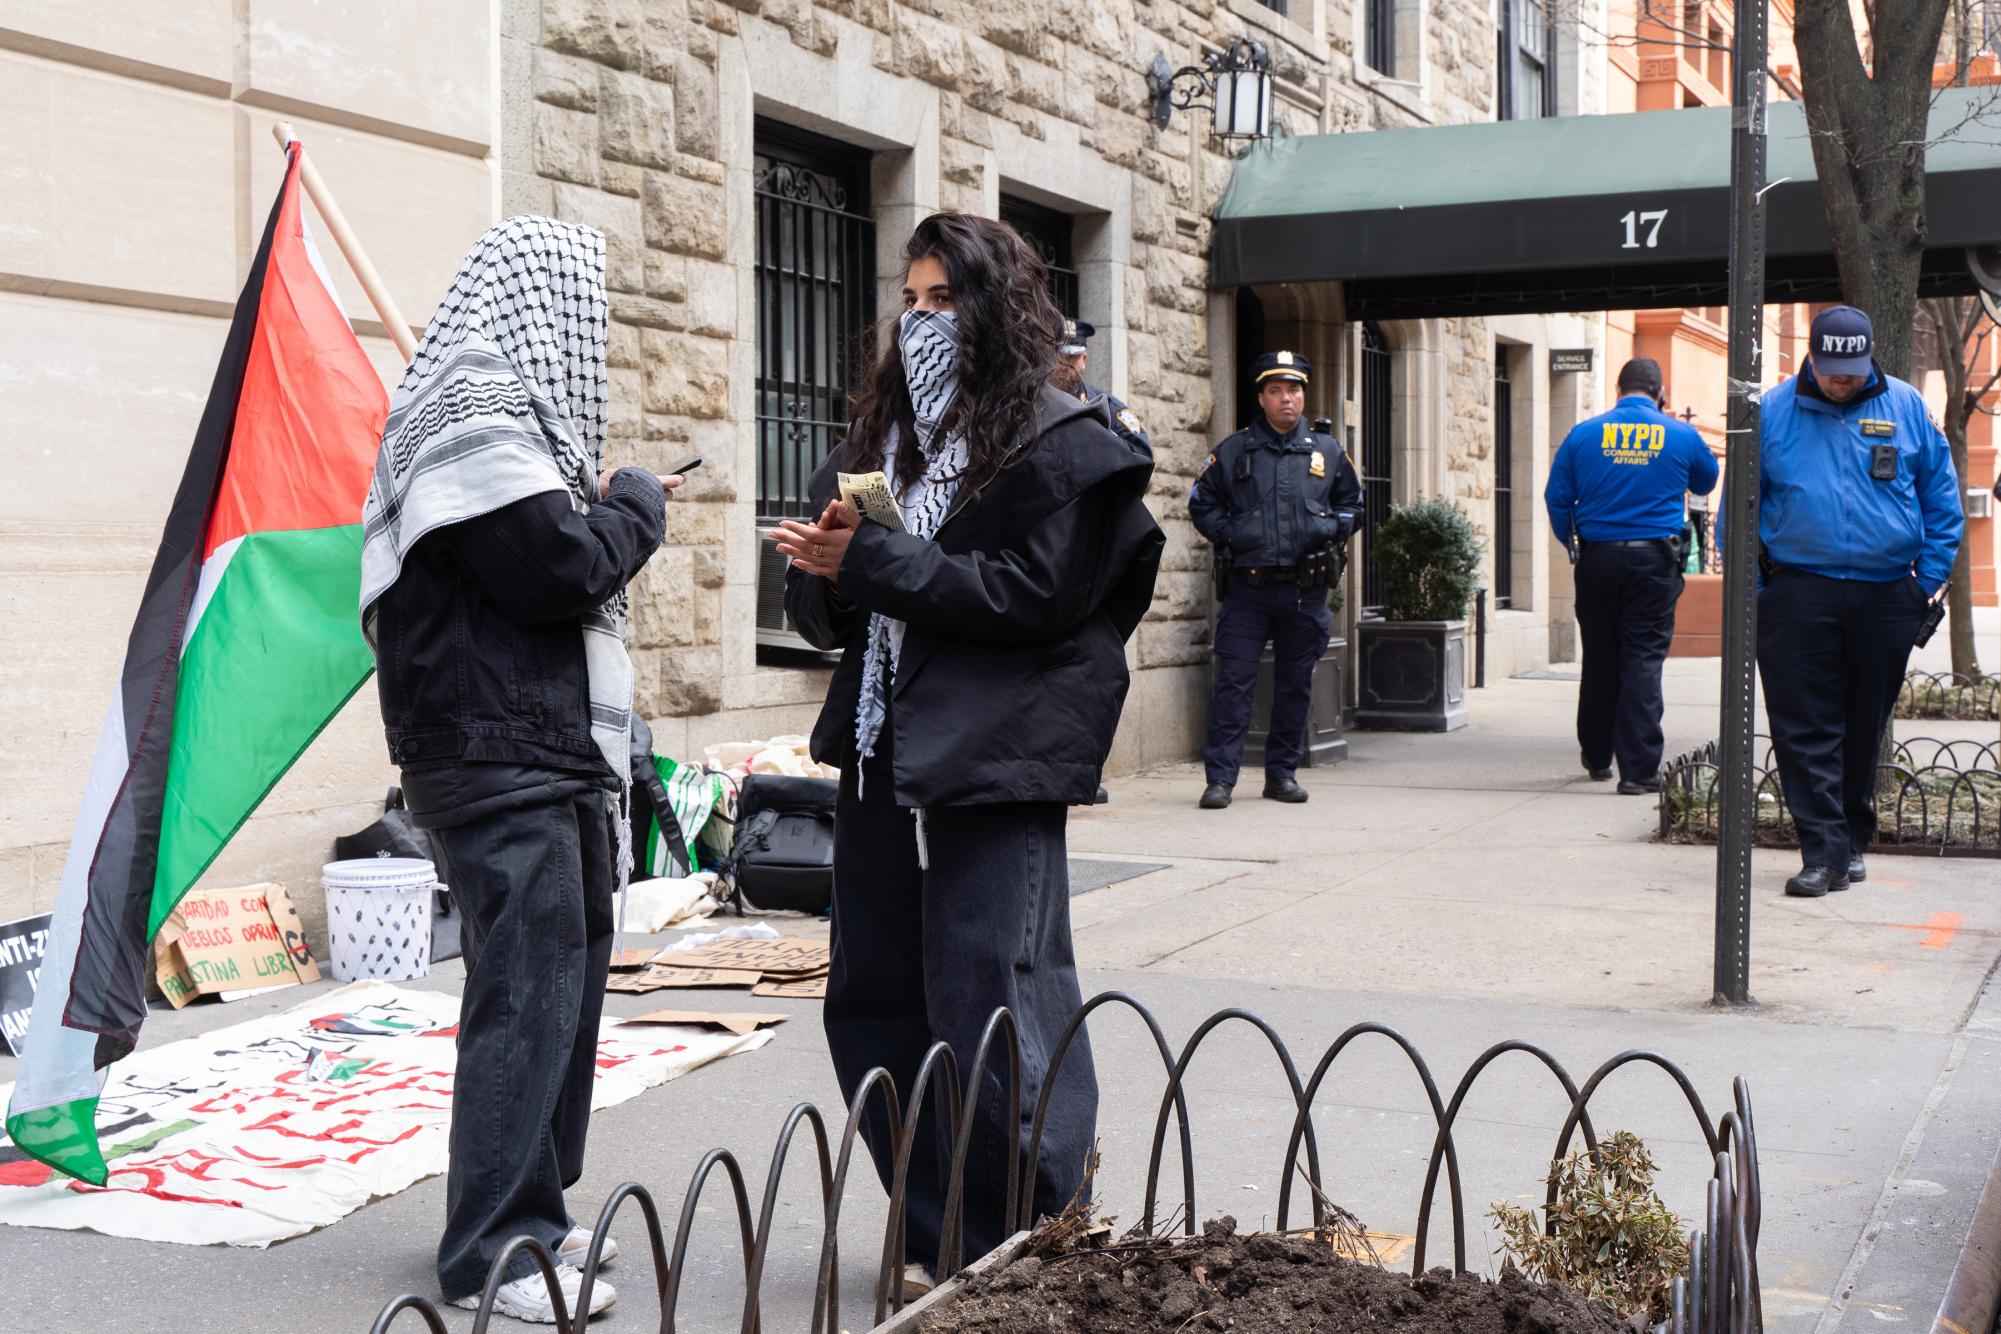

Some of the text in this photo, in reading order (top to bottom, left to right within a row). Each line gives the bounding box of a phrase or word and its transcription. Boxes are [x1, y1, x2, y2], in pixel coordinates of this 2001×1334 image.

[1620, 208, 1668, 248] 17
[1822, 334, 1867, 353] NYPD
[1552, 362, 1590, 371] ENTRANCE
[1601, 422, 1665, 450] NYPD
[1602, 449, 1661, 459] COMMUNITY
[1613, 456, 1650, 466] AFFAIRS
